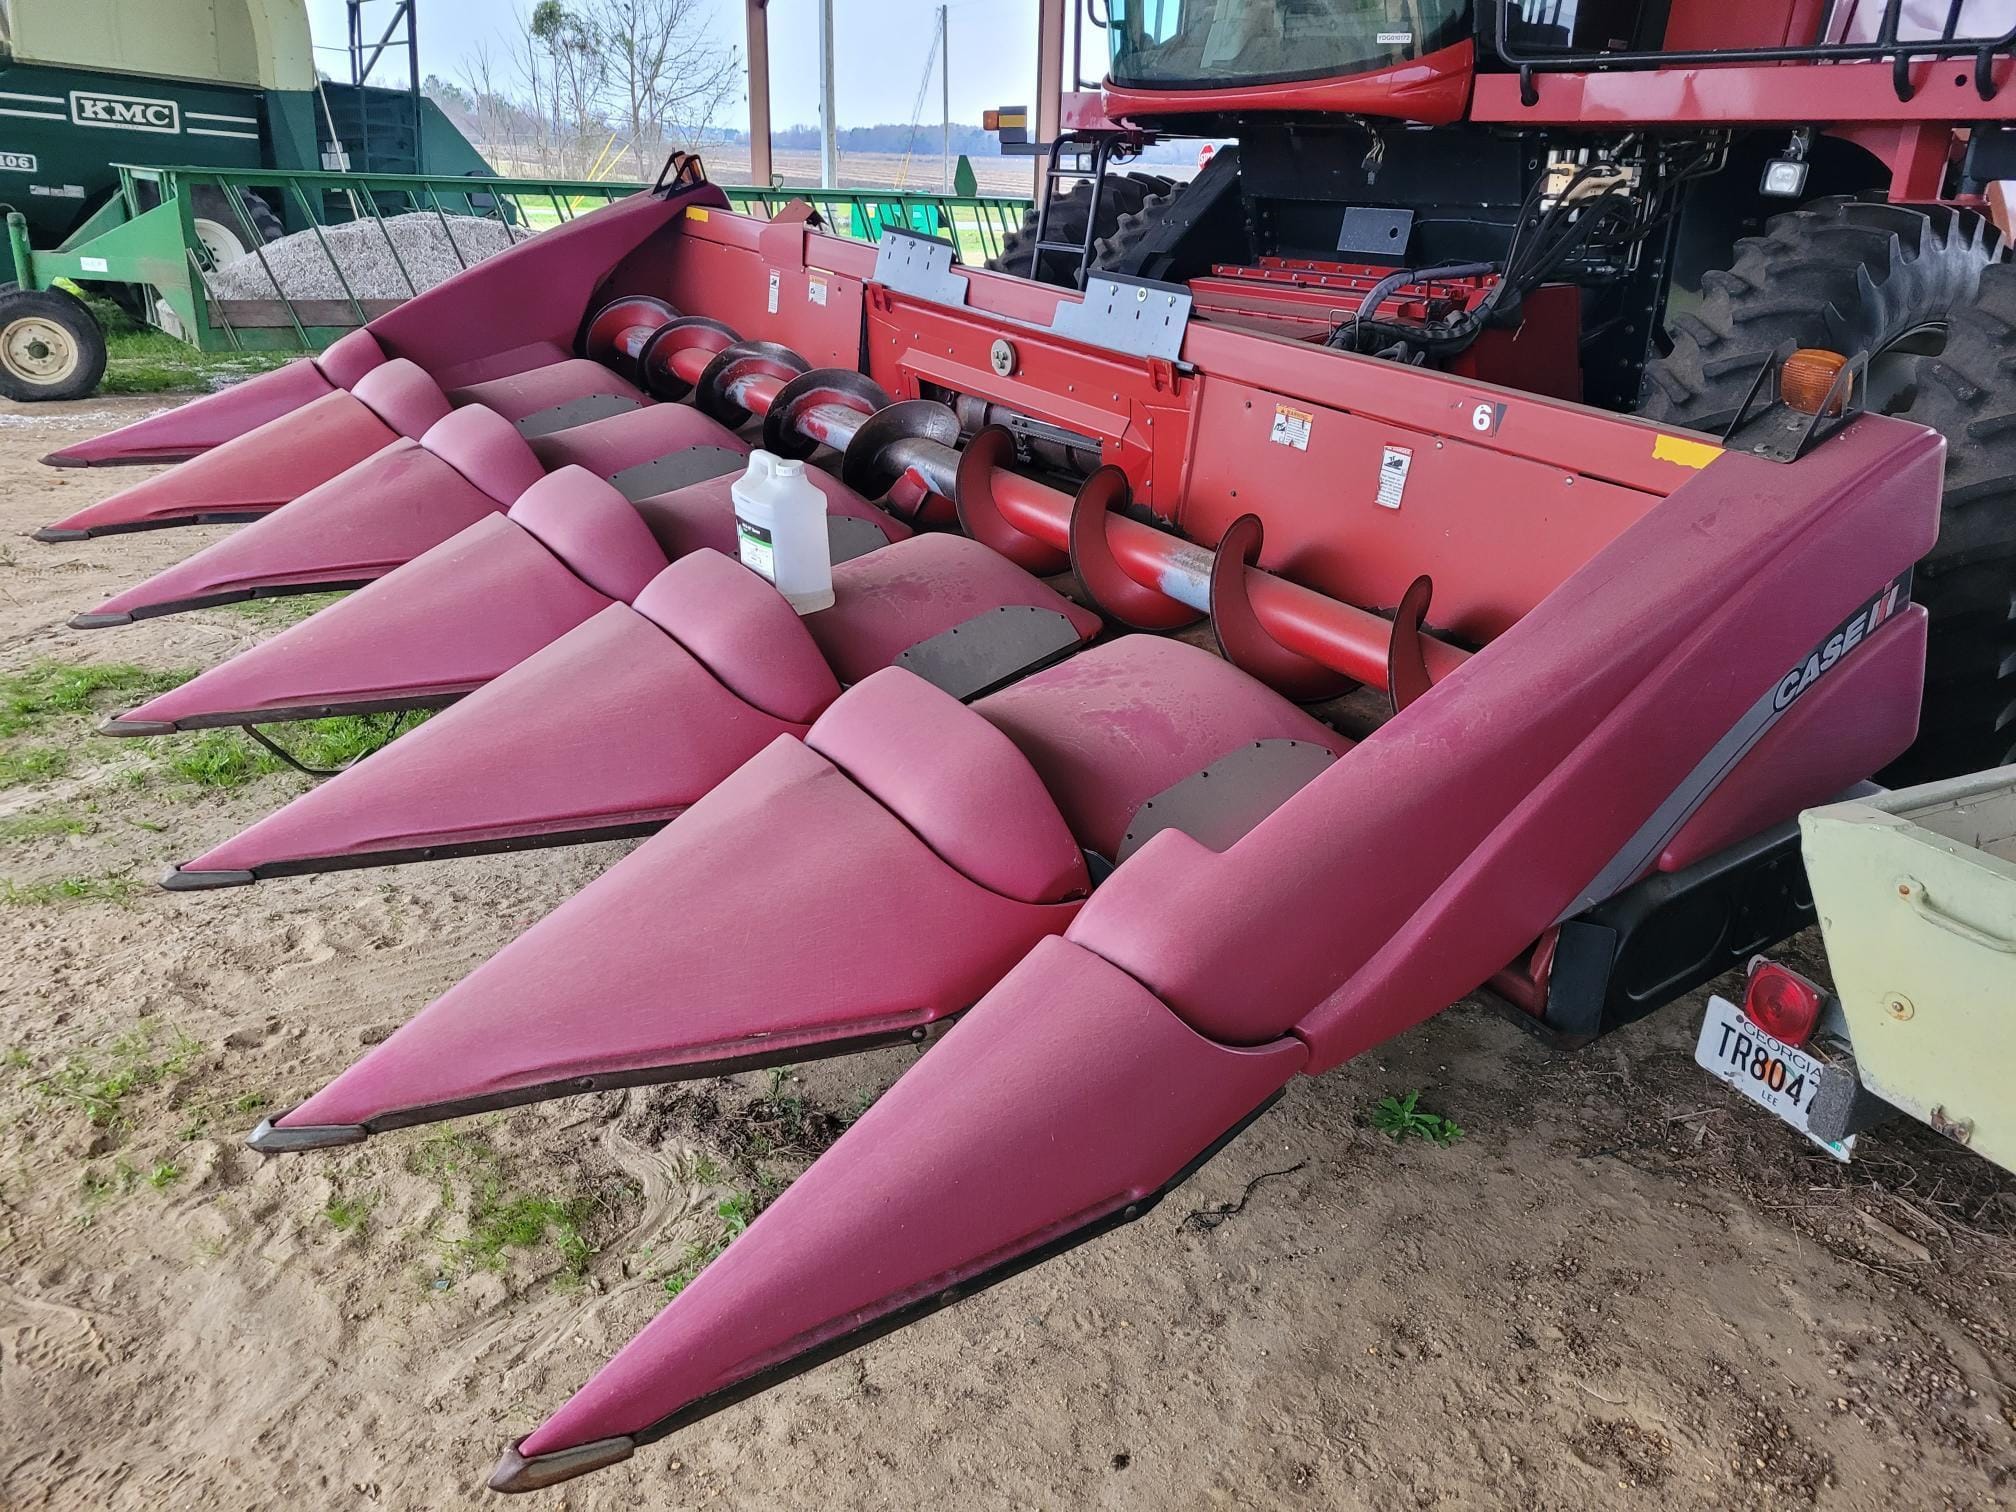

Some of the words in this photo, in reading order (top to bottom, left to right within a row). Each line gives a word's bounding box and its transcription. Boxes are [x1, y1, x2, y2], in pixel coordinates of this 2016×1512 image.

[80, 99, 170, 125] KMC
[1472, 404, 1493, 431] 6
[1773, 611, 1868, 710] CASE
[1743, 1021, 1822, 1078] GEORGIA
[1761, 1089, 1779, 1107] LEE
